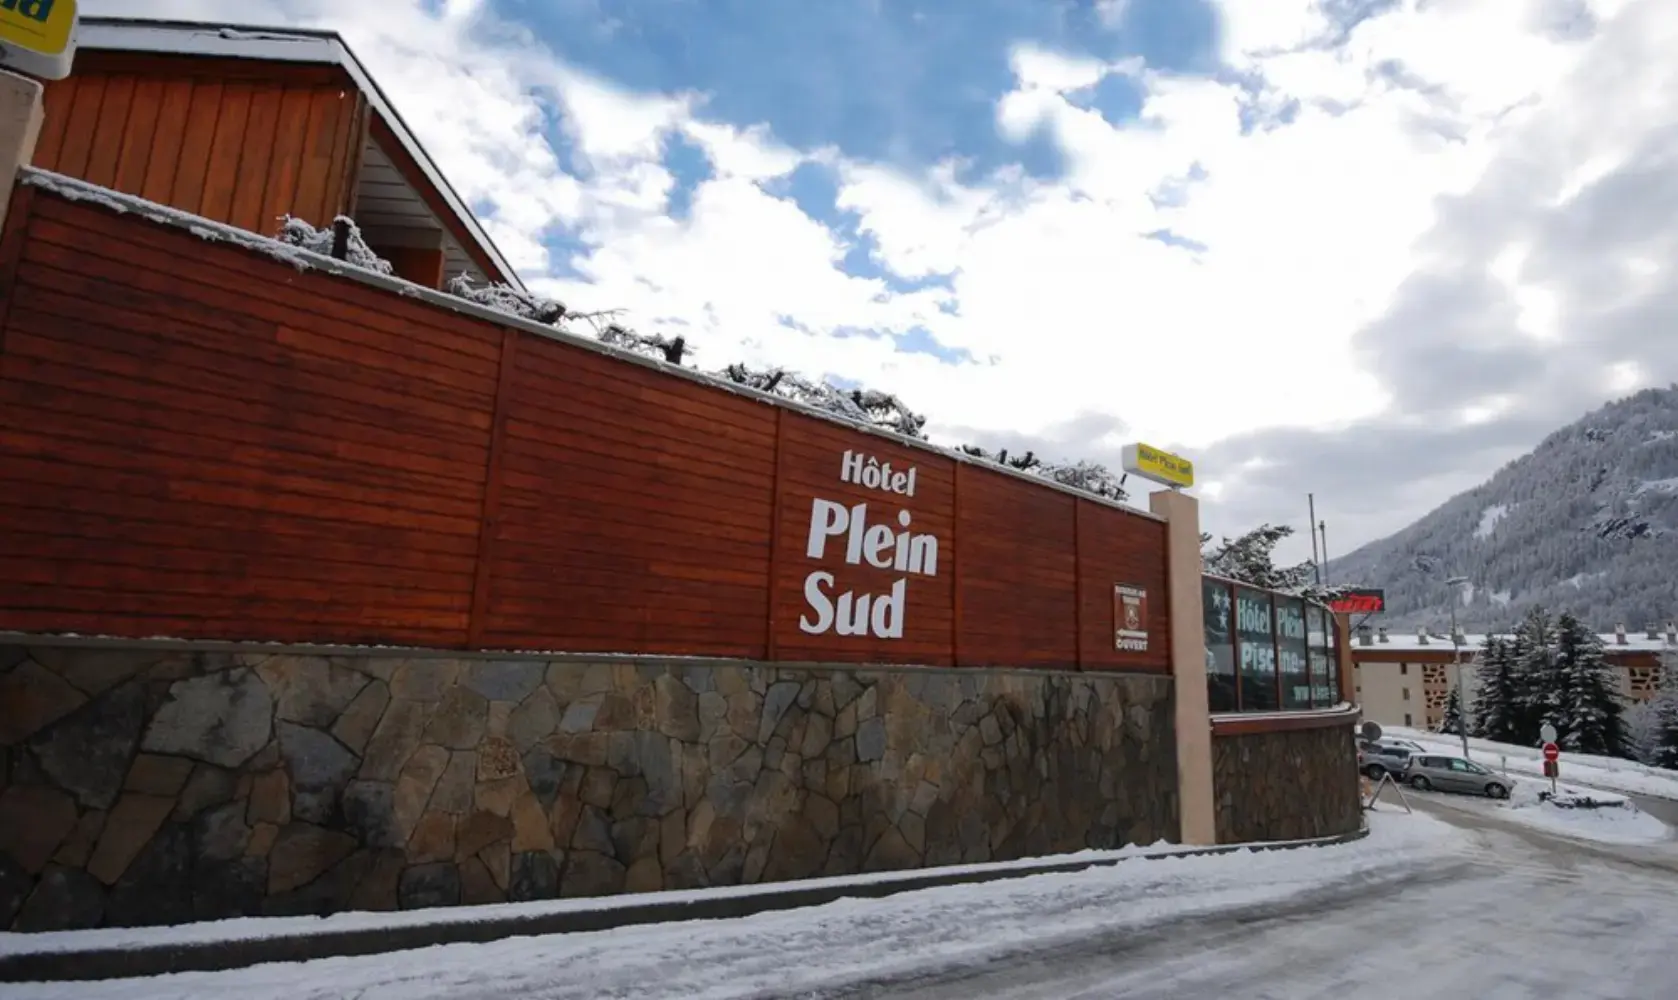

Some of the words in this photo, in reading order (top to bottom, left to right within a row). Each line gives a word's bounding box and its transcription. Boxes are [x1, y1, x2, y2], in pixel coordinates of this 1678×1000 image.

[841, 450, 916, 497] Hôtel
[807, 498, 938, 576] Plein
[800, 571, 905, 639] Sud
[1236, 598, 1271, 633] Hôtel
